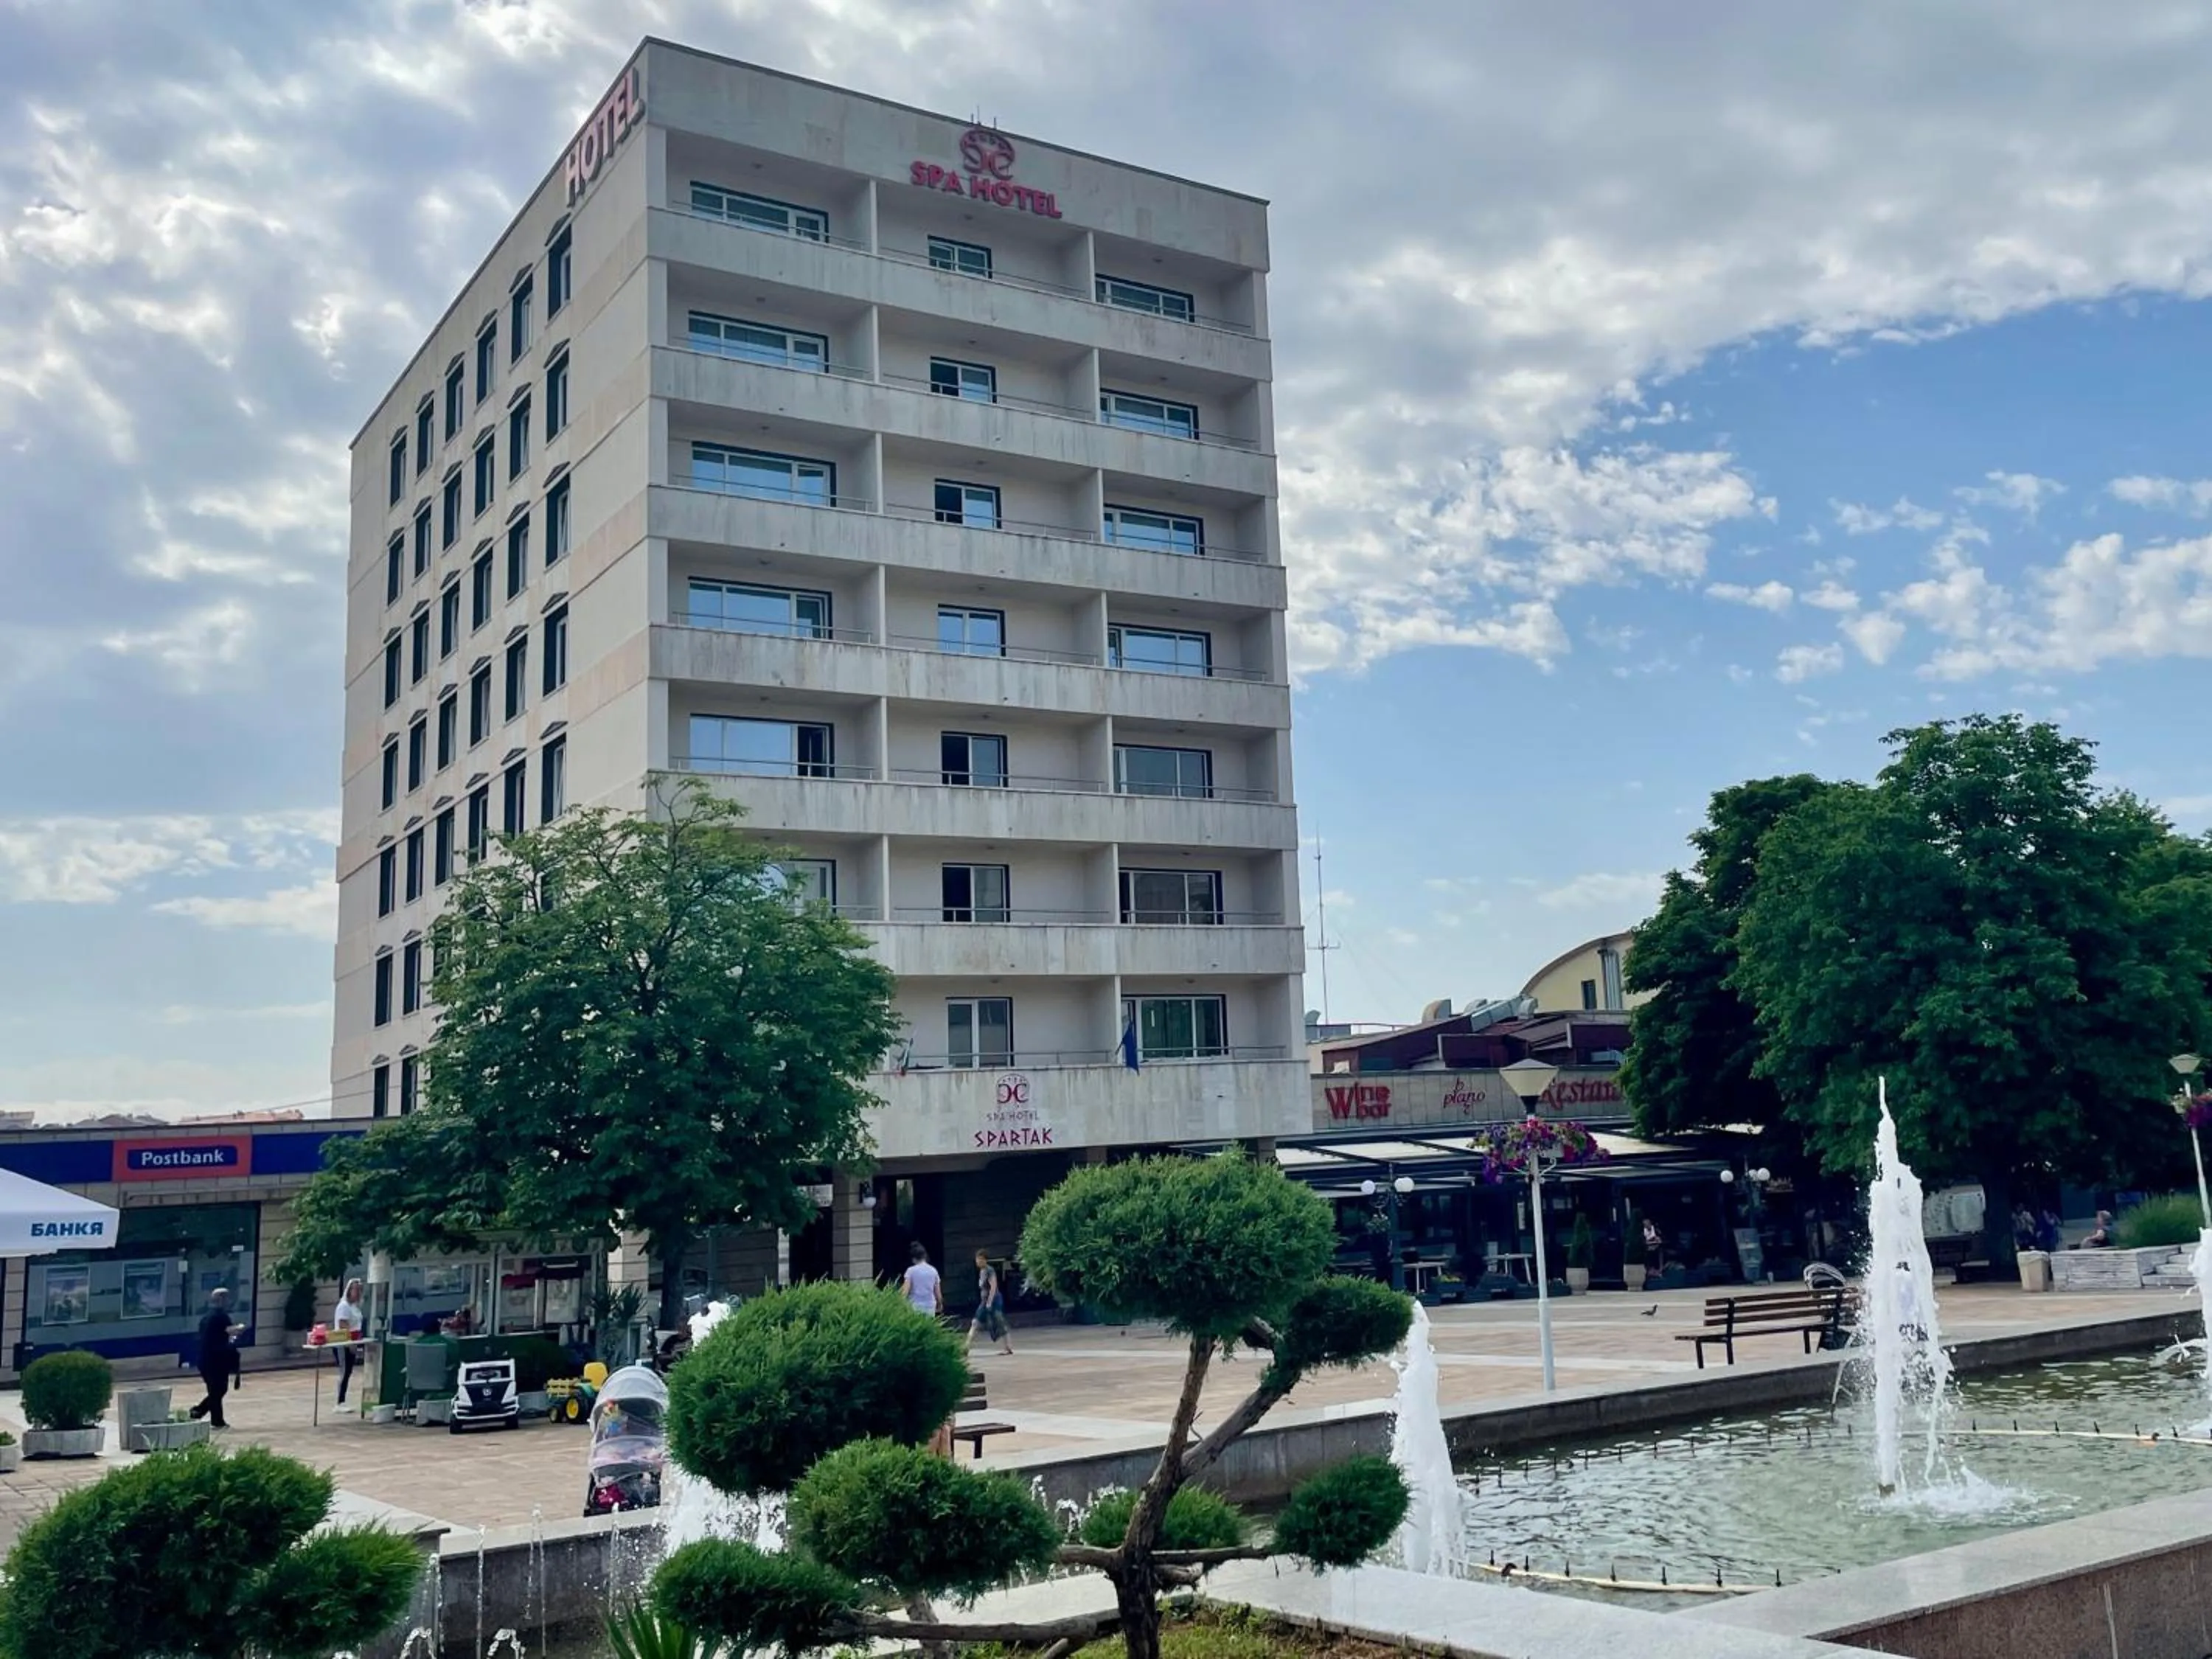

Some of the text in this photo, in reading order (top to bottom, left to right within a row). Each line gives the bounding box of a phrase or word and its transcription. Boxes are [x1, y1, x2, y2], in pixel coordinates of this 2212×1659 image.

[565, 66, 646, 208] HOTEL
[910, 160, 1062, 219] SPA HOTEL
[987, 1110, 1040, 1121] SPA HOTEL
[973, 1127, 1054, 1147] SPARTAK
[141, 1150, 225, 1166] Postbank
[30, 1221, 104, 1237] БАНКЯ
